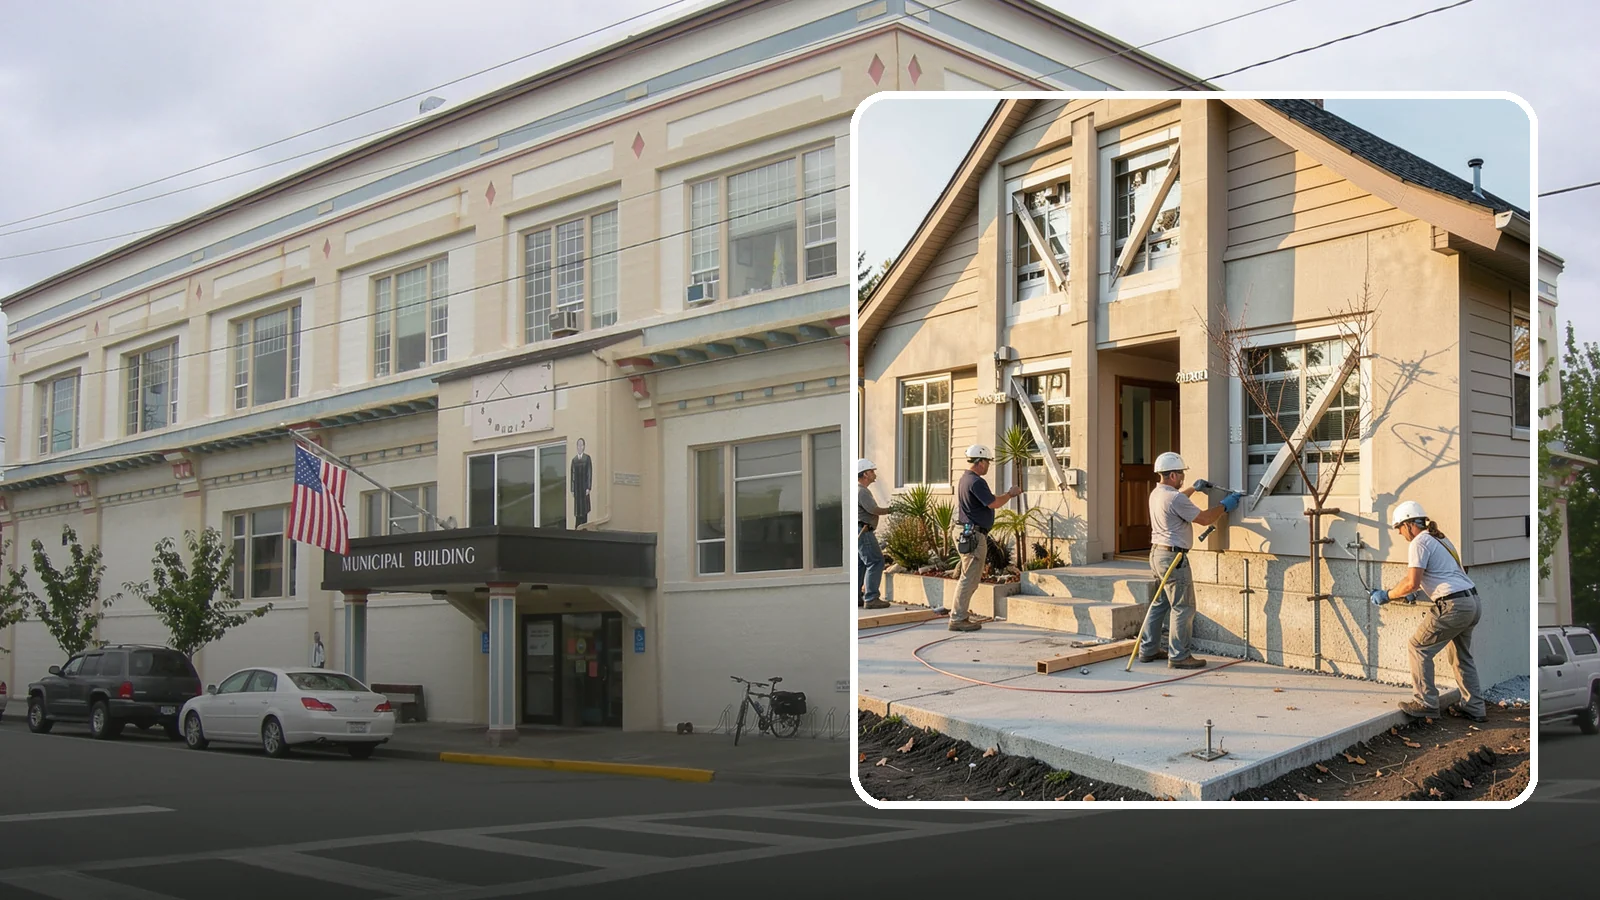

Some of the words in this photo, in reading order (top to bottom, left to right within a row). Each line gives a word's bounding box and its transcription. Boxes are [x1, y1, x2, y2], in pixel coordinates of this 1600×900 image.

[529, 414, 532, 422] 3
[342, 552, 405, 572] MUNICIPAL
[414, 546, 475, 567] BUILDING
